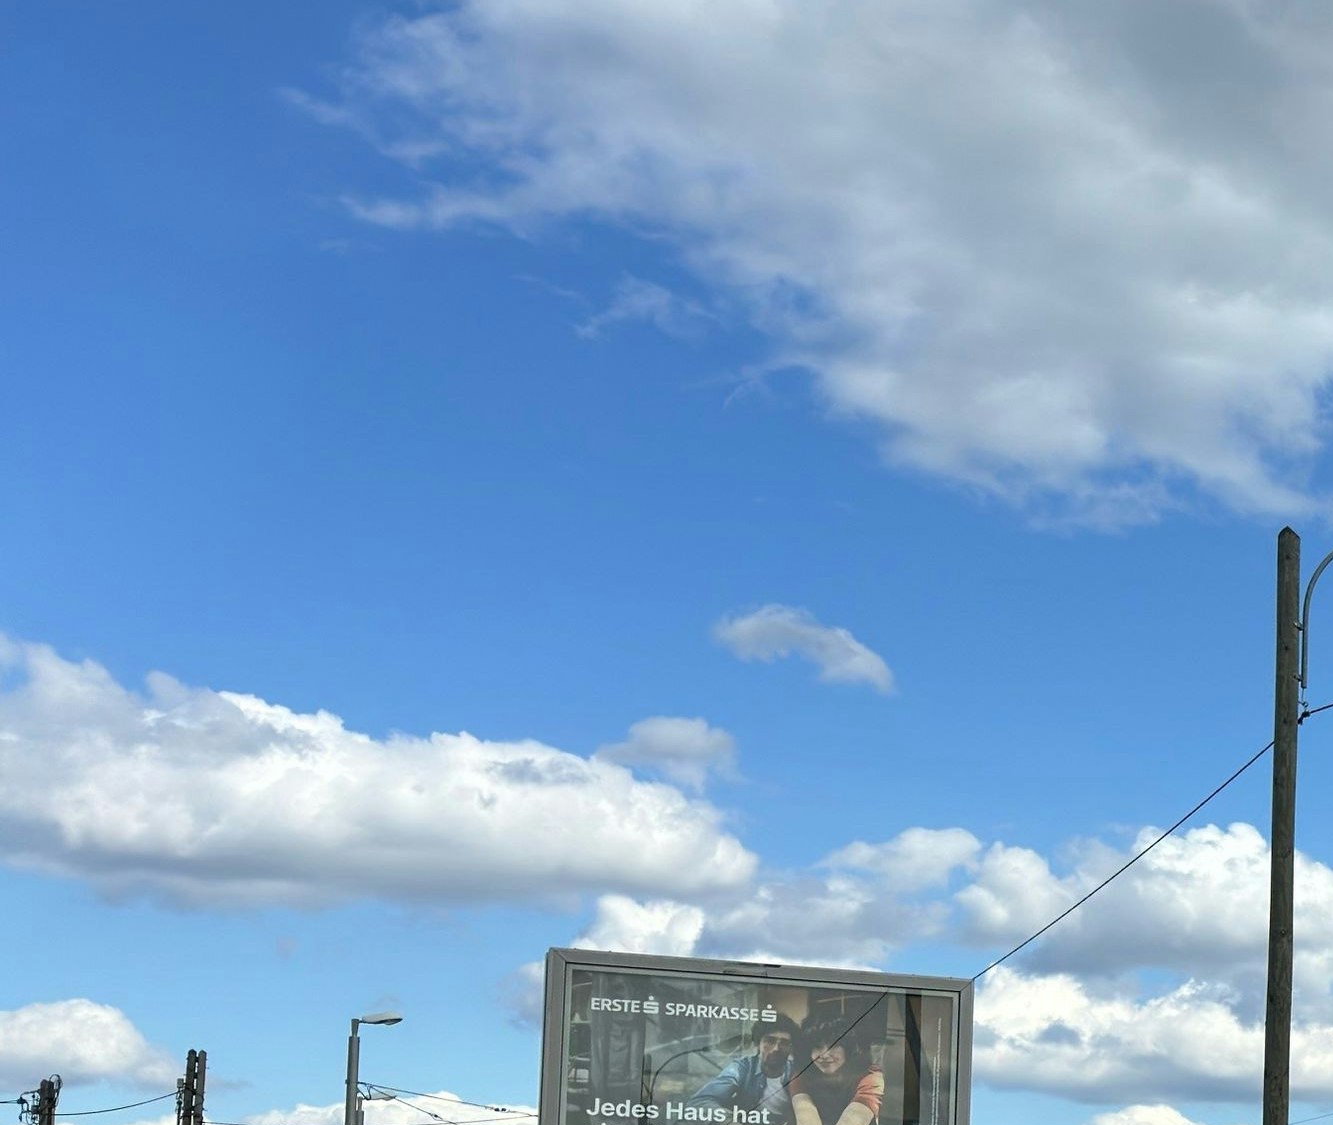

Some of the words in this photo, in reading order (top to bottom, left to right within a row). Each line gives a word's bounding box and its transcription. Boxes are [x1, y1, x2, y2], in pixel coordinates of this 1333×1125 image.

[590, 997, 641, 1013] ERSTE
[665, 1002, 760, 1021] SPARKASSE
[586, 1097, 660, 1119] Jedes
[665, 1101, 727, 1122] Haus
[732, 1105, 770, 1124] hat
